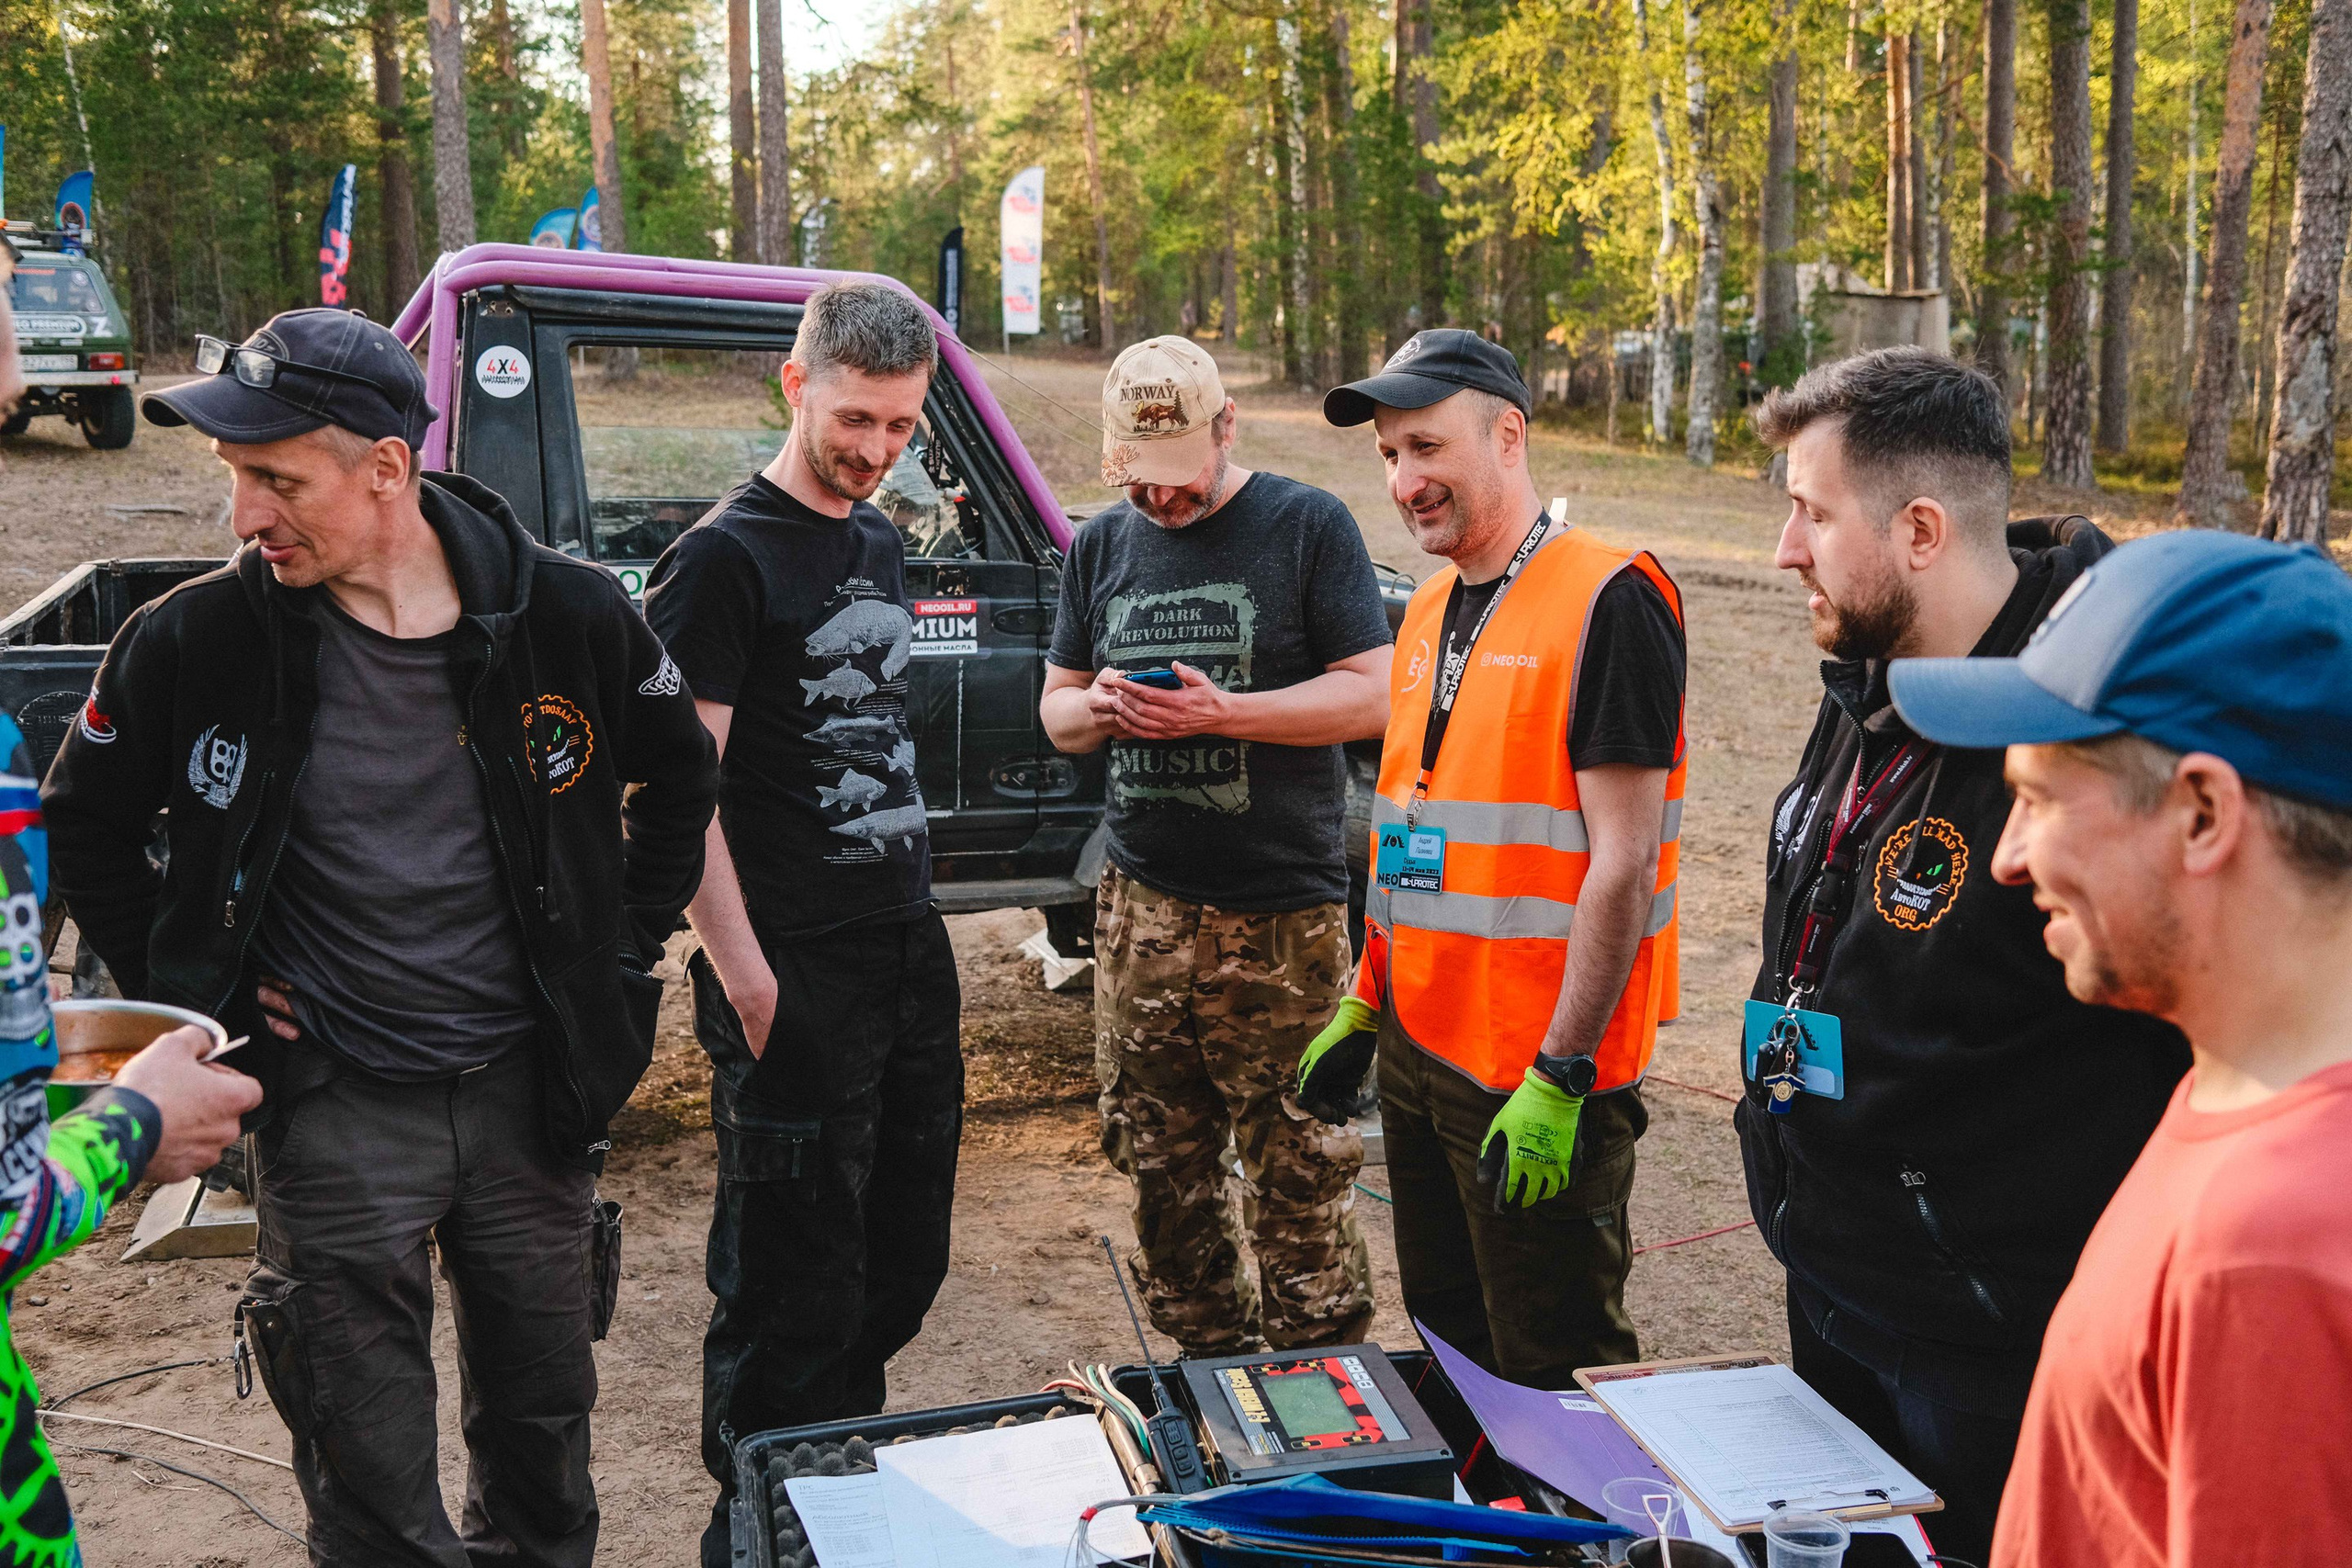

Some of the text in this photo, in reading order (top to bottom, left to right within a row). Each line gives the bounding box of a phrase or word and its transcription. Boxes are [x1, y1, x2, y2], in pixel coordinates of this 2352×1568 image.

[487, 358, 519, 374] 4X4
[1120, 385, 1175, 401] NORWAY
[1515, 521, 1545, 563] SUPROTEC
[921, 603, 972, 613] NEOOIL.RU
[1476, 579, 1507, 628] SUPROTEC
[1153, 607, 1202, 624] DARK
[1119, 625, 1236, 643] REVOLUTION
[1492, 654, 1538, 668] NEO OIL
[1448, 645, 1472, 696] SUPROTEC
[1118, 747, 1236, 773] MUSIC
[1884, 833, 1912, 865] WE'RE
[1935, 828, 1956, 850] MAD
[1950, 852, 1962, 886] HERE
[1377, 873, 1398, 886] NEO
[1407, 878, 1439, 889] SUPROTEC
[1894, 905, 1917, 922] ORG
[1516, 1152, 1558, 1167] DEXTERITY
